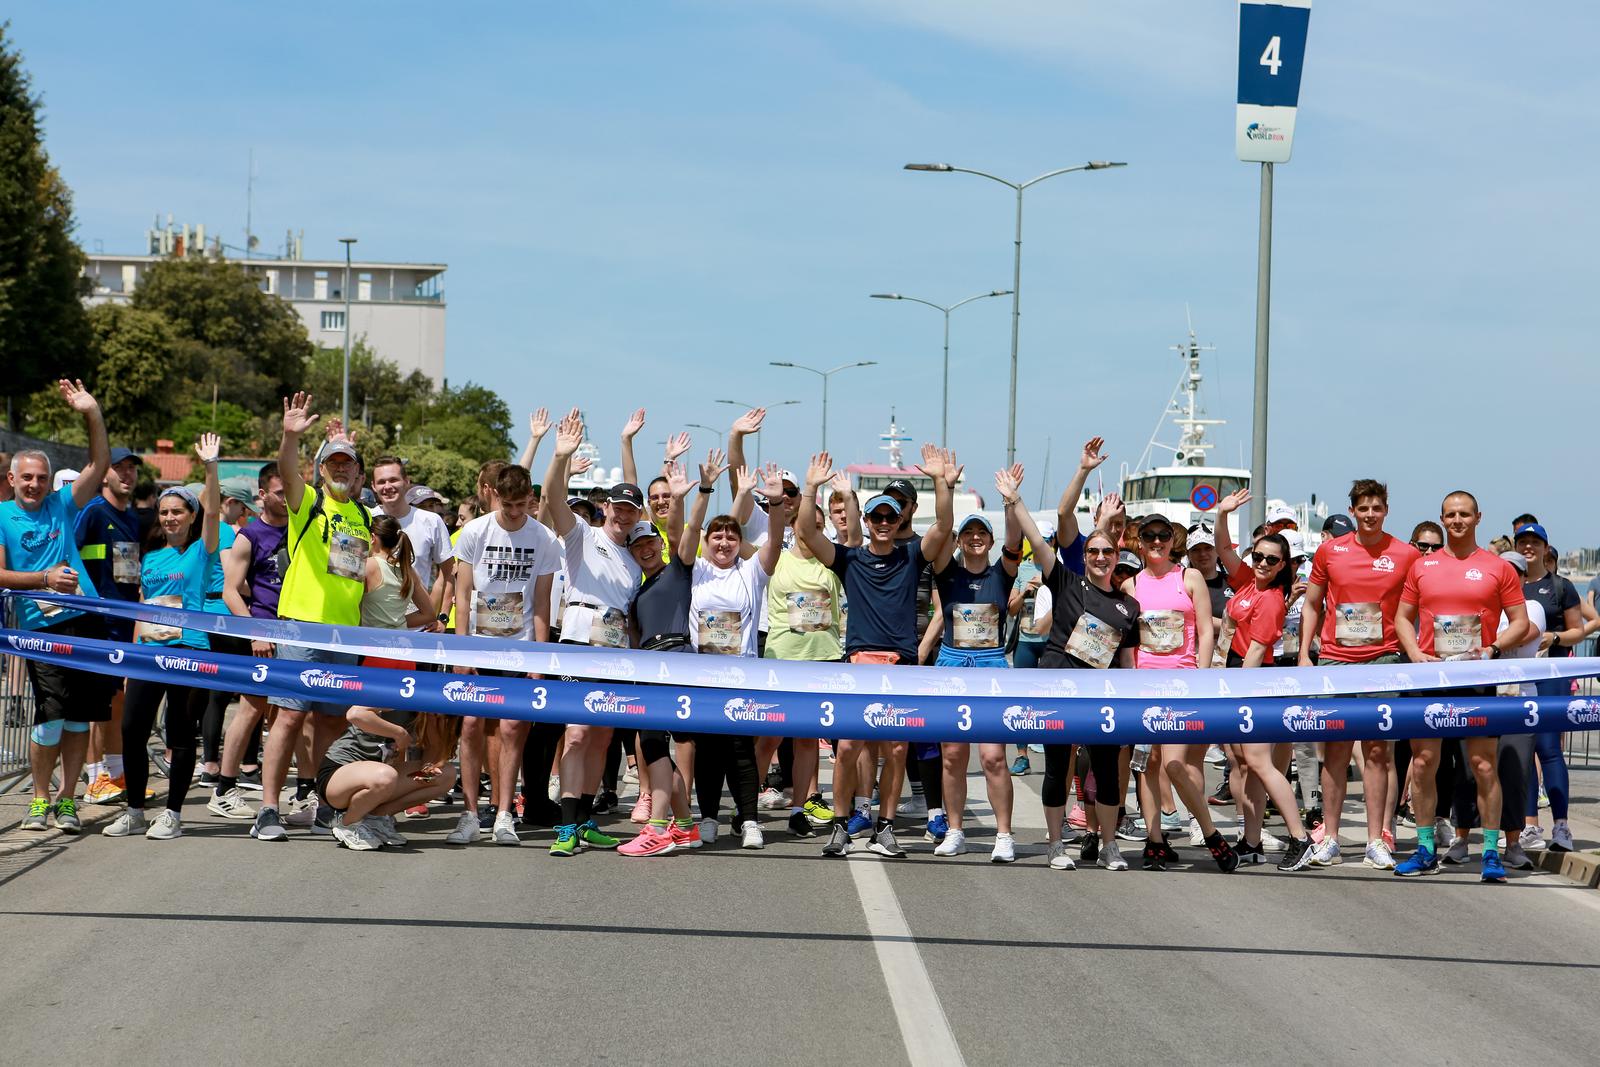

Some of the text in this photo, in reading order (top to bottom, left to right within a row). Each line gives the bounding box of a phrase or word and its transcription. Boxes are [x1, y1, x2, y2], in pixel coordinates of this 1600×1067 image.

[1259, 35, 1282, 76] 4
[251, 664, 269, 683] 3
[399, 676, 416, 699] 3
[531, 686, 548, 710] 3
[675, 695, 692, 720] 3
[819, 701, 835, 727] 3
[957, 704, 973, 732] 3
[1100, 705, 1116, 734] 3
[1238, 705, 1254, 734] 3
[1377, 703, 1393, 731] 3
[1523, 700, 1540, 727] 3
